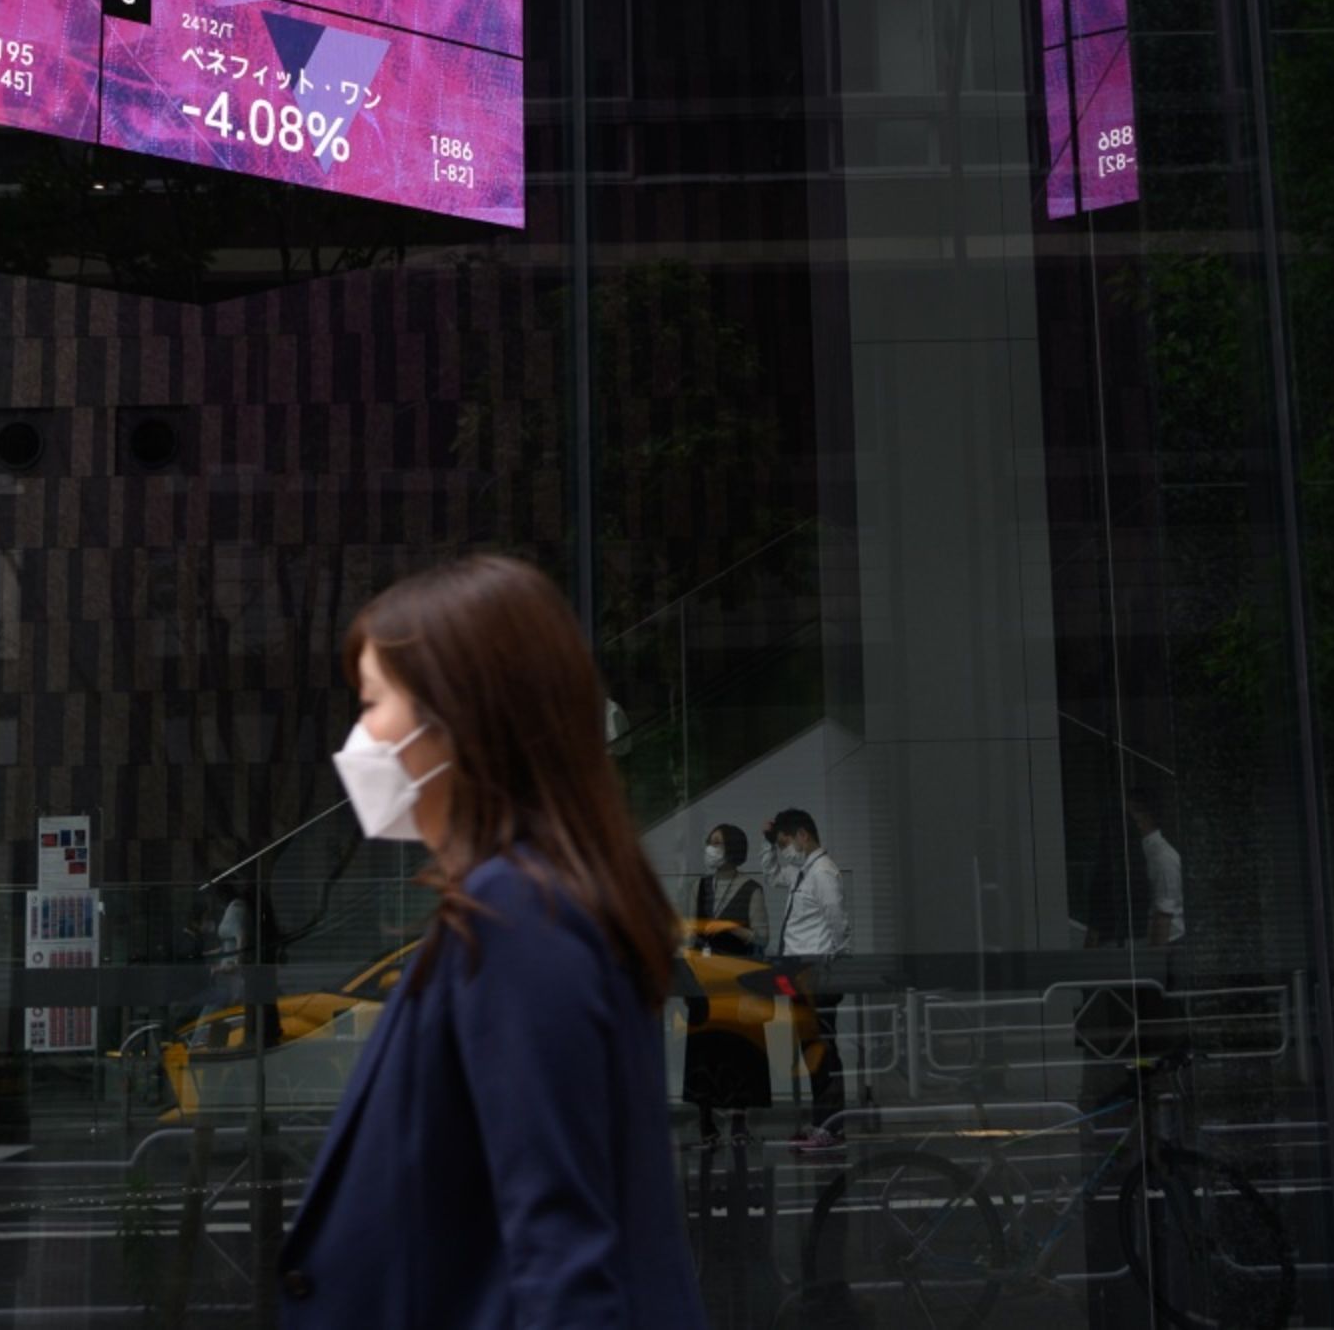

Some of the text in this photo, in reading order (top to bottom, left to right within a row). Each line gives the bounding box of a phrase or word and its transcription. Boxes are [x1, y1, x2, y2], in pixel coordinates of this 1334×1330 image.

[181, 13, 234, 39] 2412/T
[181, 45, 382, 109] ベネフィット・ワン
[181, 91, 350, 163] -4.08%
[430, 135, 473, 162] 1886
[432, 159, 473, 188] [-82]
